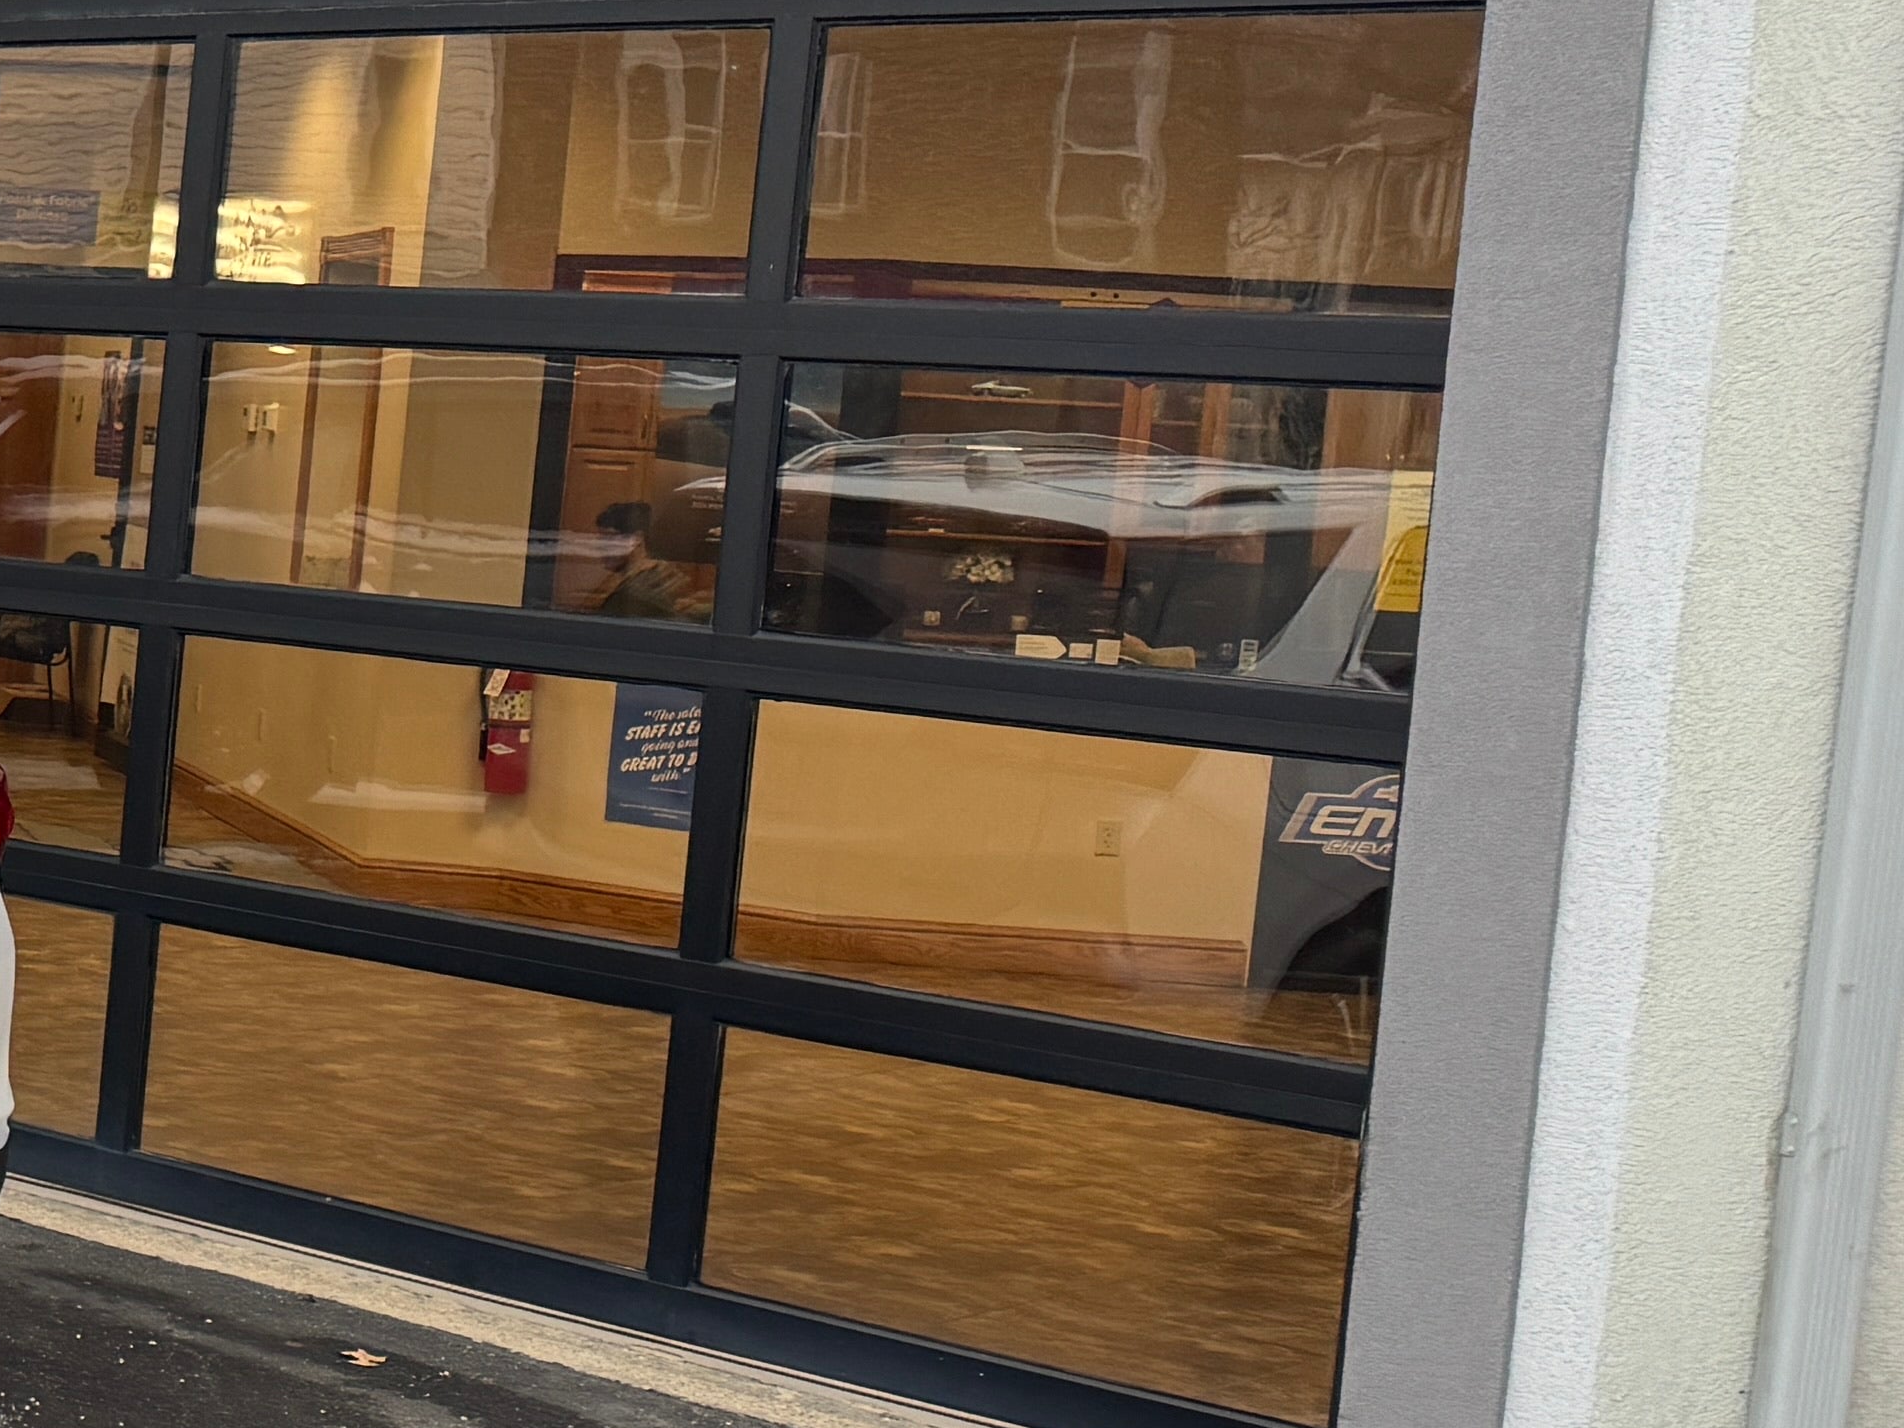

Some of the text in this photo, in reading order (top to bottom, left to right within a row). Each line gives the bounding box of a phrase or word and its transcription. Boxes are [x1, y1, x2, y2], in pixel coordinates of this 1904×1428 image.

[625, 723, 669, 741] STAFF
[669, 722, 686, 736] IS
[641, 738, 675, 754] going
[620, 755, 666, 773] GREAT
[669, 753, 685, 769] TO
